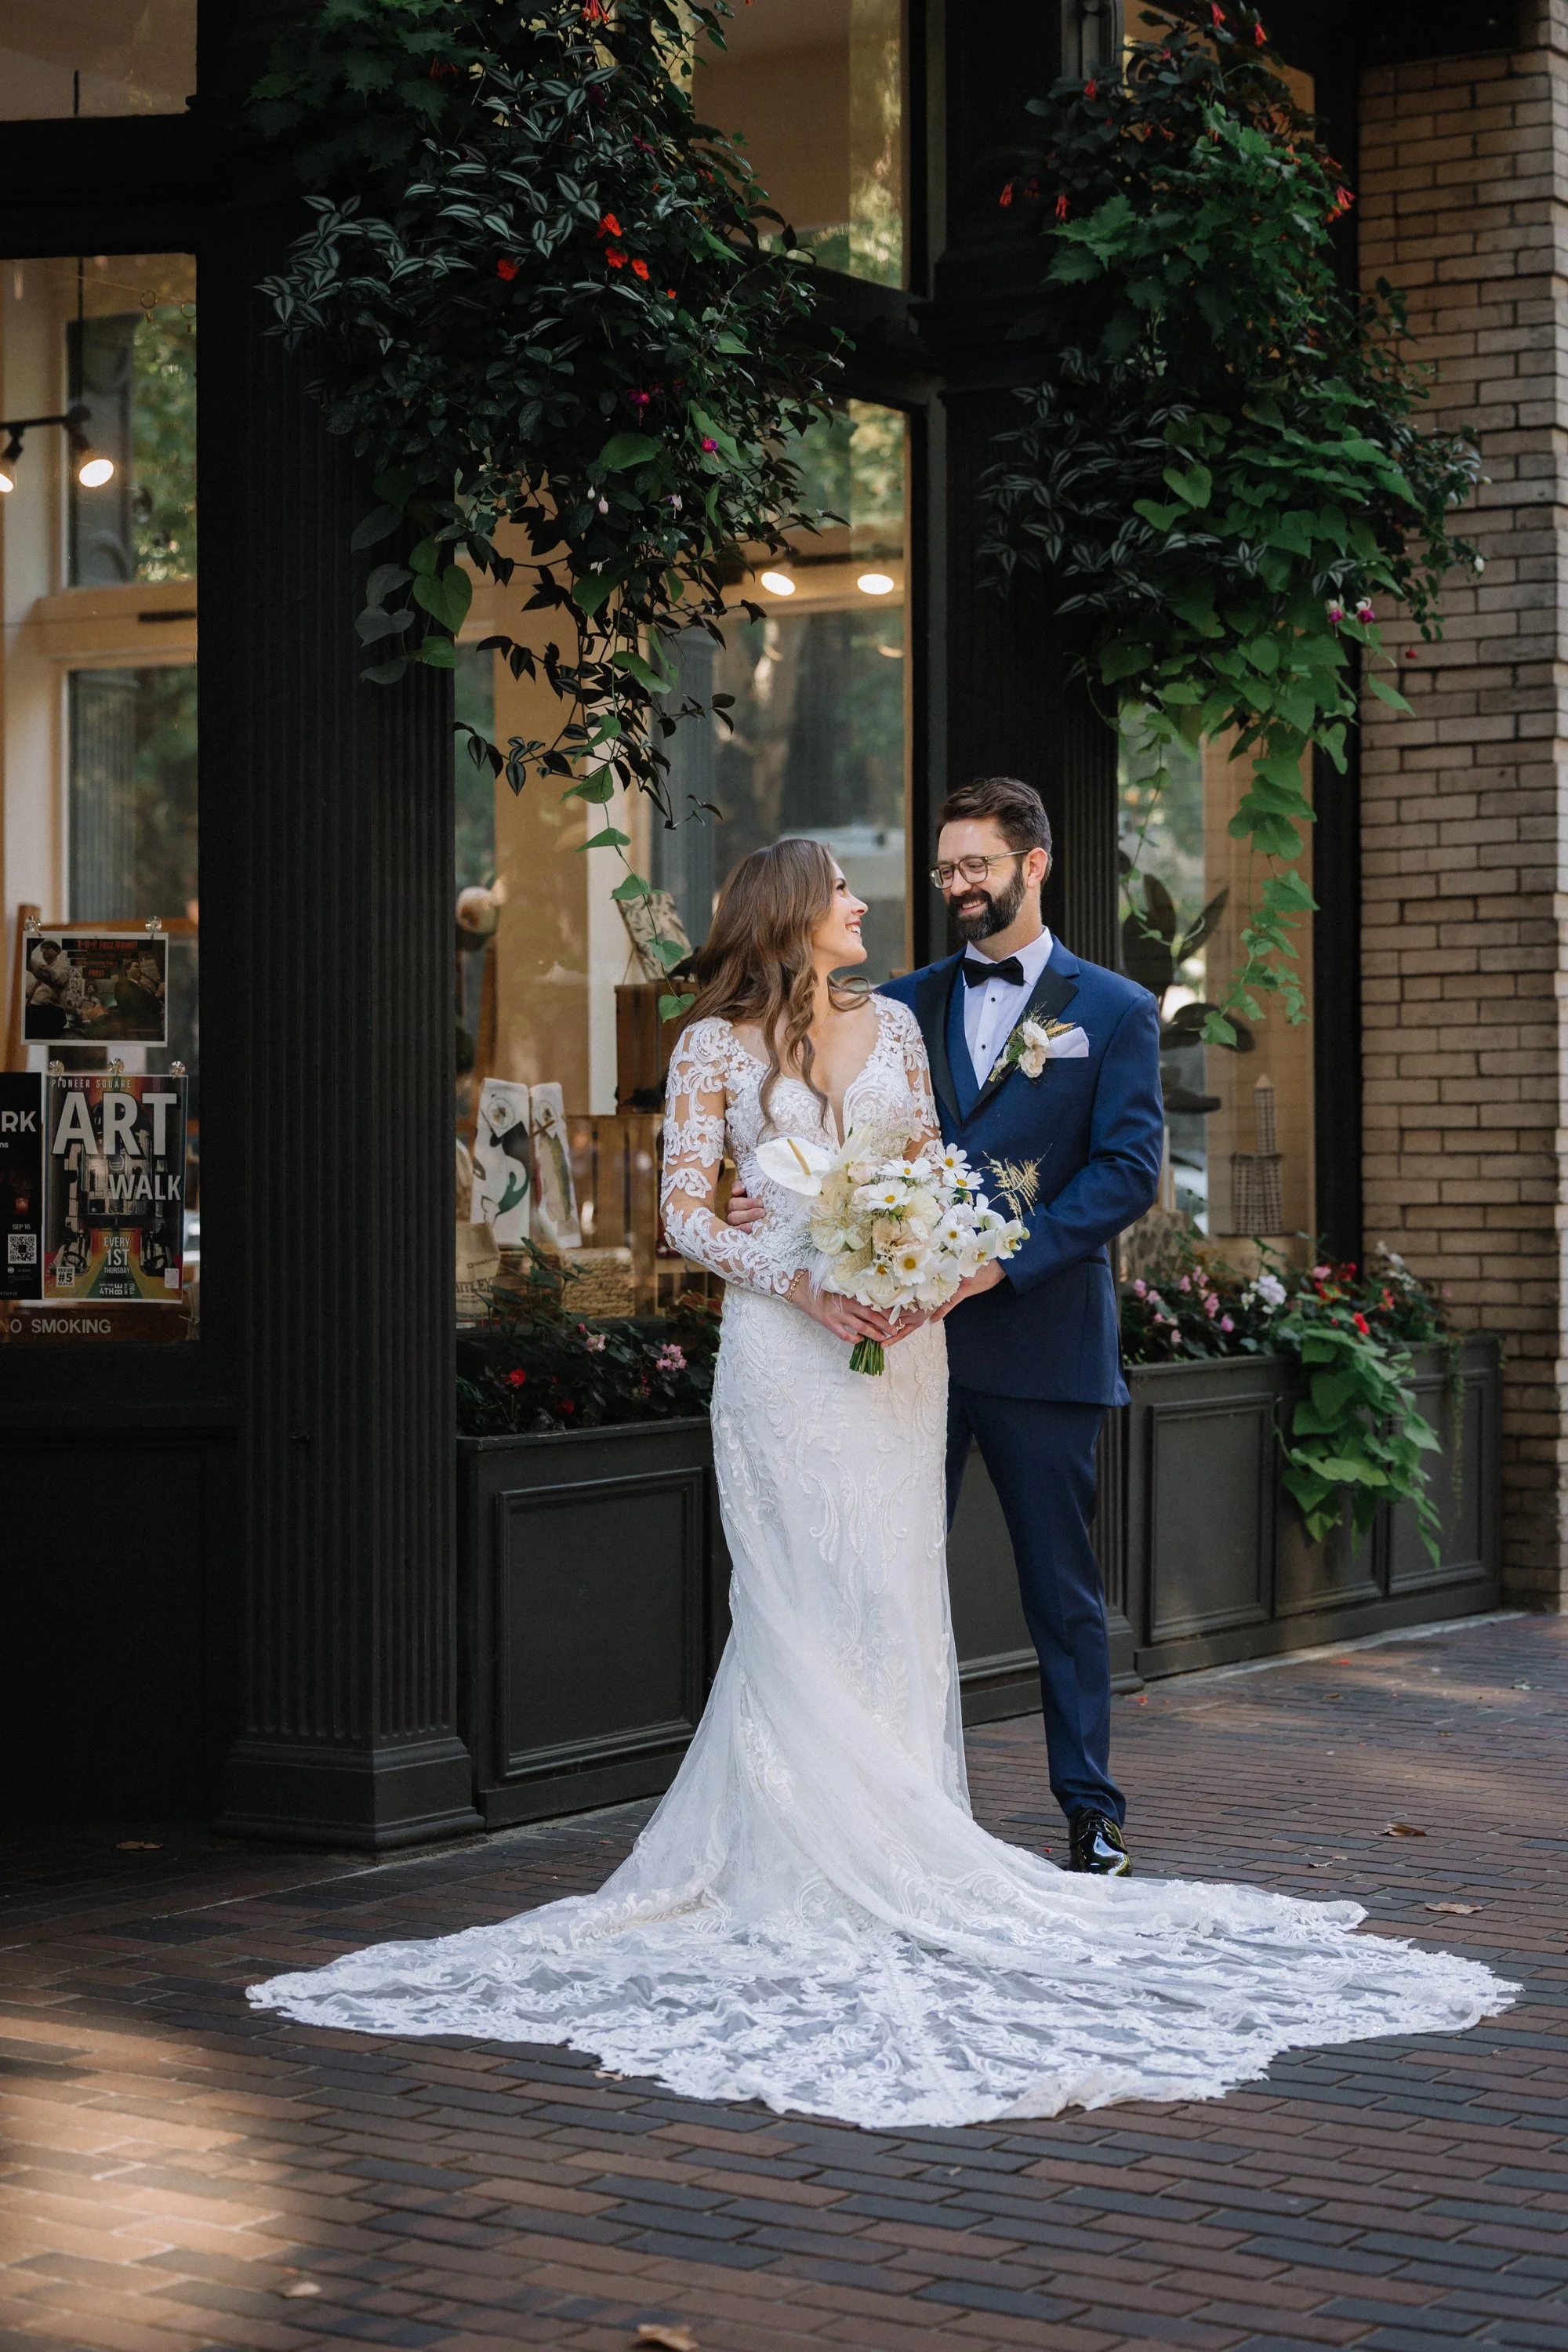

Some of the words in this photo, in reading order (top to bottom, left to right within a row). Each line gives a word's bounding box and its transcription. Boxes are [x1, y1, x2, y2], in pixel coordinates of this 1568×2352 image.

[52, 1079, 90, 1088] PIONEER
[96, 1079, 132, 1089] SQUARE
[2, 1110, 36, 1132] RK
[52, 1091, 177, 1156] ART
[108, 1174, 181, 1200] WALK
[103, 1236, 130, 1247] EVERY
[106, 1248, 130, 1266] 1ST
[58, 1272, 73, 1283] #5
[114, 1283, 123, 1295] BE
[0, 1319, 22, 1334] NO
[31, 1319, 111, 1334] SMOKING
